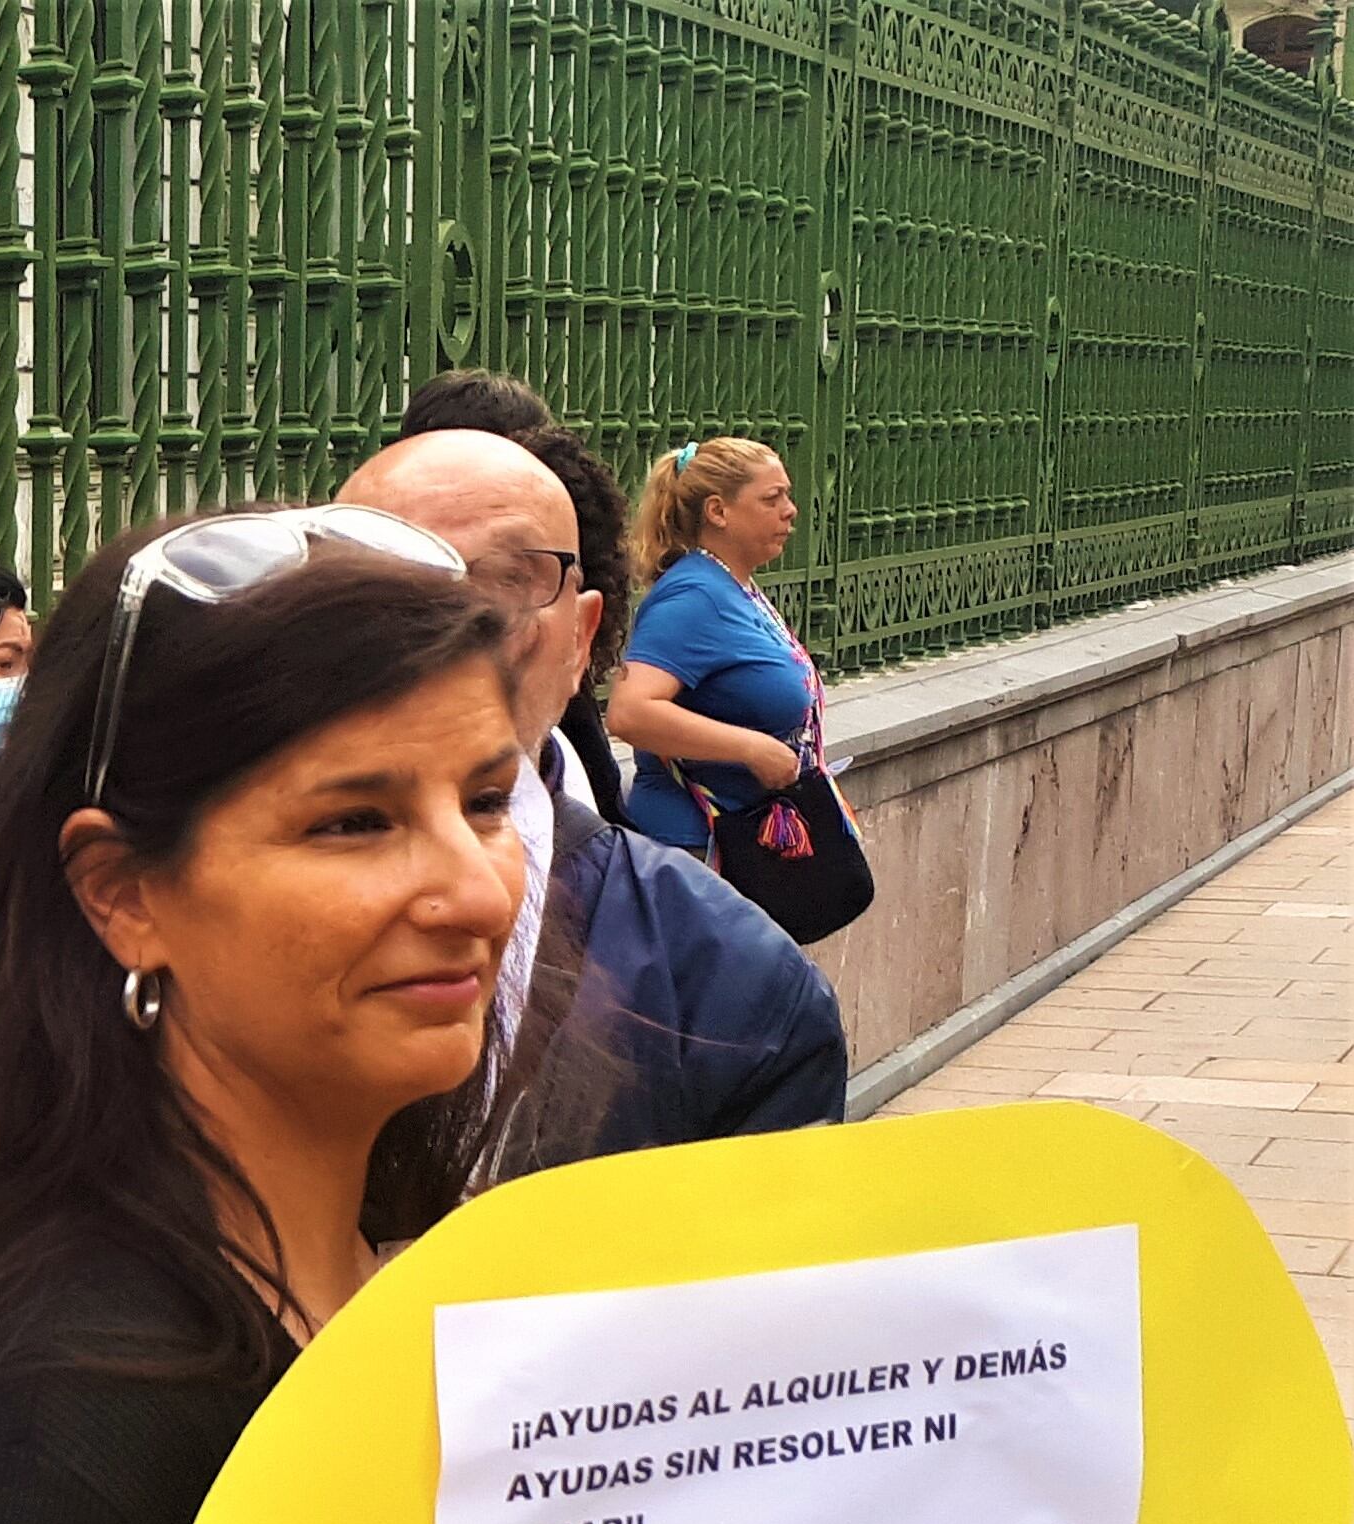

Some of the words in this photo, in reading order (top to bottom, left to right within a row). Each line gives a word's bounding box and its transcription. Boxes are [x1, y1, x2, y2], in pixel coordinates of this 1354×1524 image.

[511, 1394, 679, 1451] ¡¡AYUDAS
[687, 1388, 732, 1419] AL
[741, 1362, 911, 1411] ALQUILER
[922, 1357, 945, 1385] Y
[954, 1339, 1067, 1382] DEMÁS
[505, 1456, 654, 1502] AYUDAS
[664, 1445, 721, 1480] SIN
[732, 1419, 914, 1470] RESOLVER
[924, 1412, 957, 1444] NI
